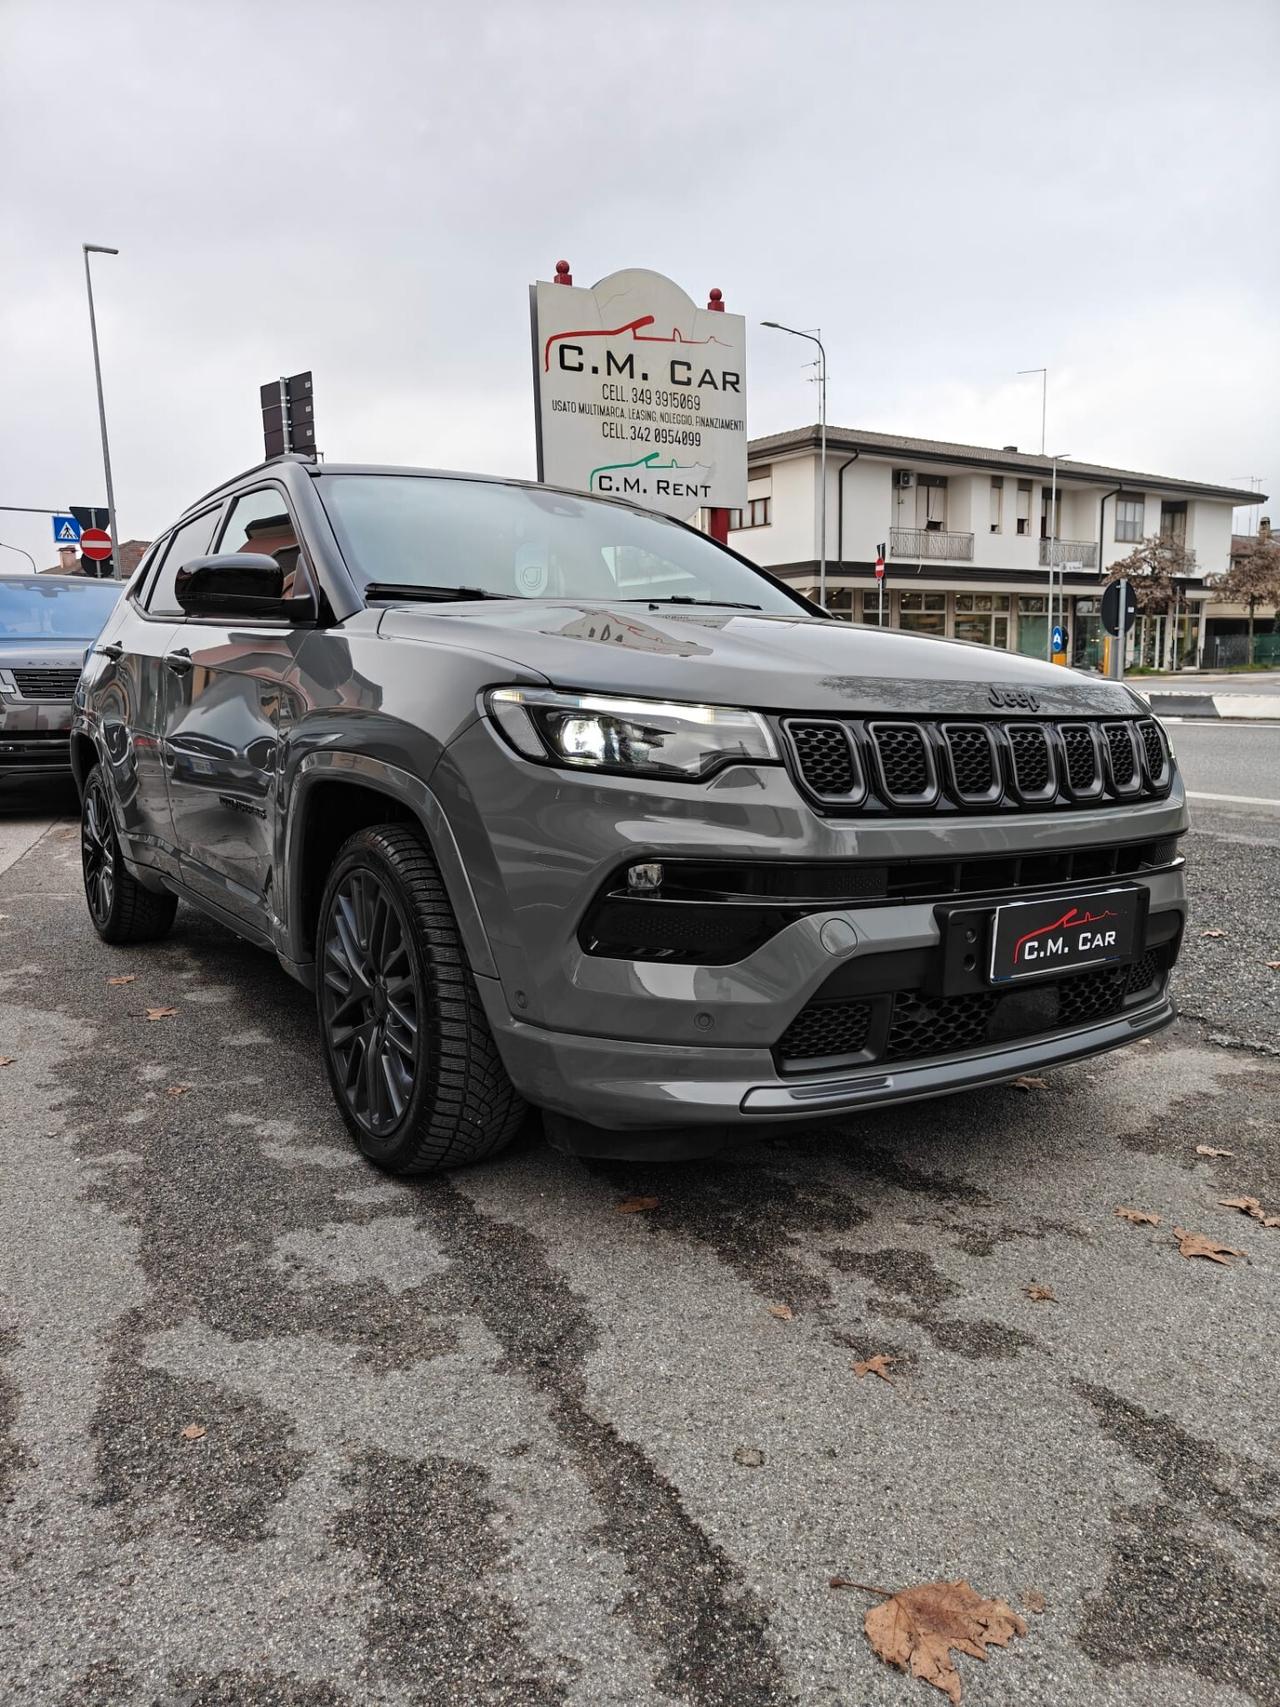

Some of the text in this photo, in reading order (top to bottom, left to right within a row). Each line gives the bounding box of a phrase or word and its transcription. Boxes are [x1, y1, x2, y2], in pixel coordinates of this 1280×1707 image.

[559, 344, 649, 381] C.M.
[602, 384, 701, 411] CELL. 349 3915069
[552, 399, 577, 414] USATO
[695, 416, 745, 432] FINANZIAMENTI
[602, 422, 701, 447] CELL. 342 0954099
[598, 475, 648, 494] C.M.
[988, 687, 1040, 712] Jeep
[1024, 936, 1069, 960] C.M.
